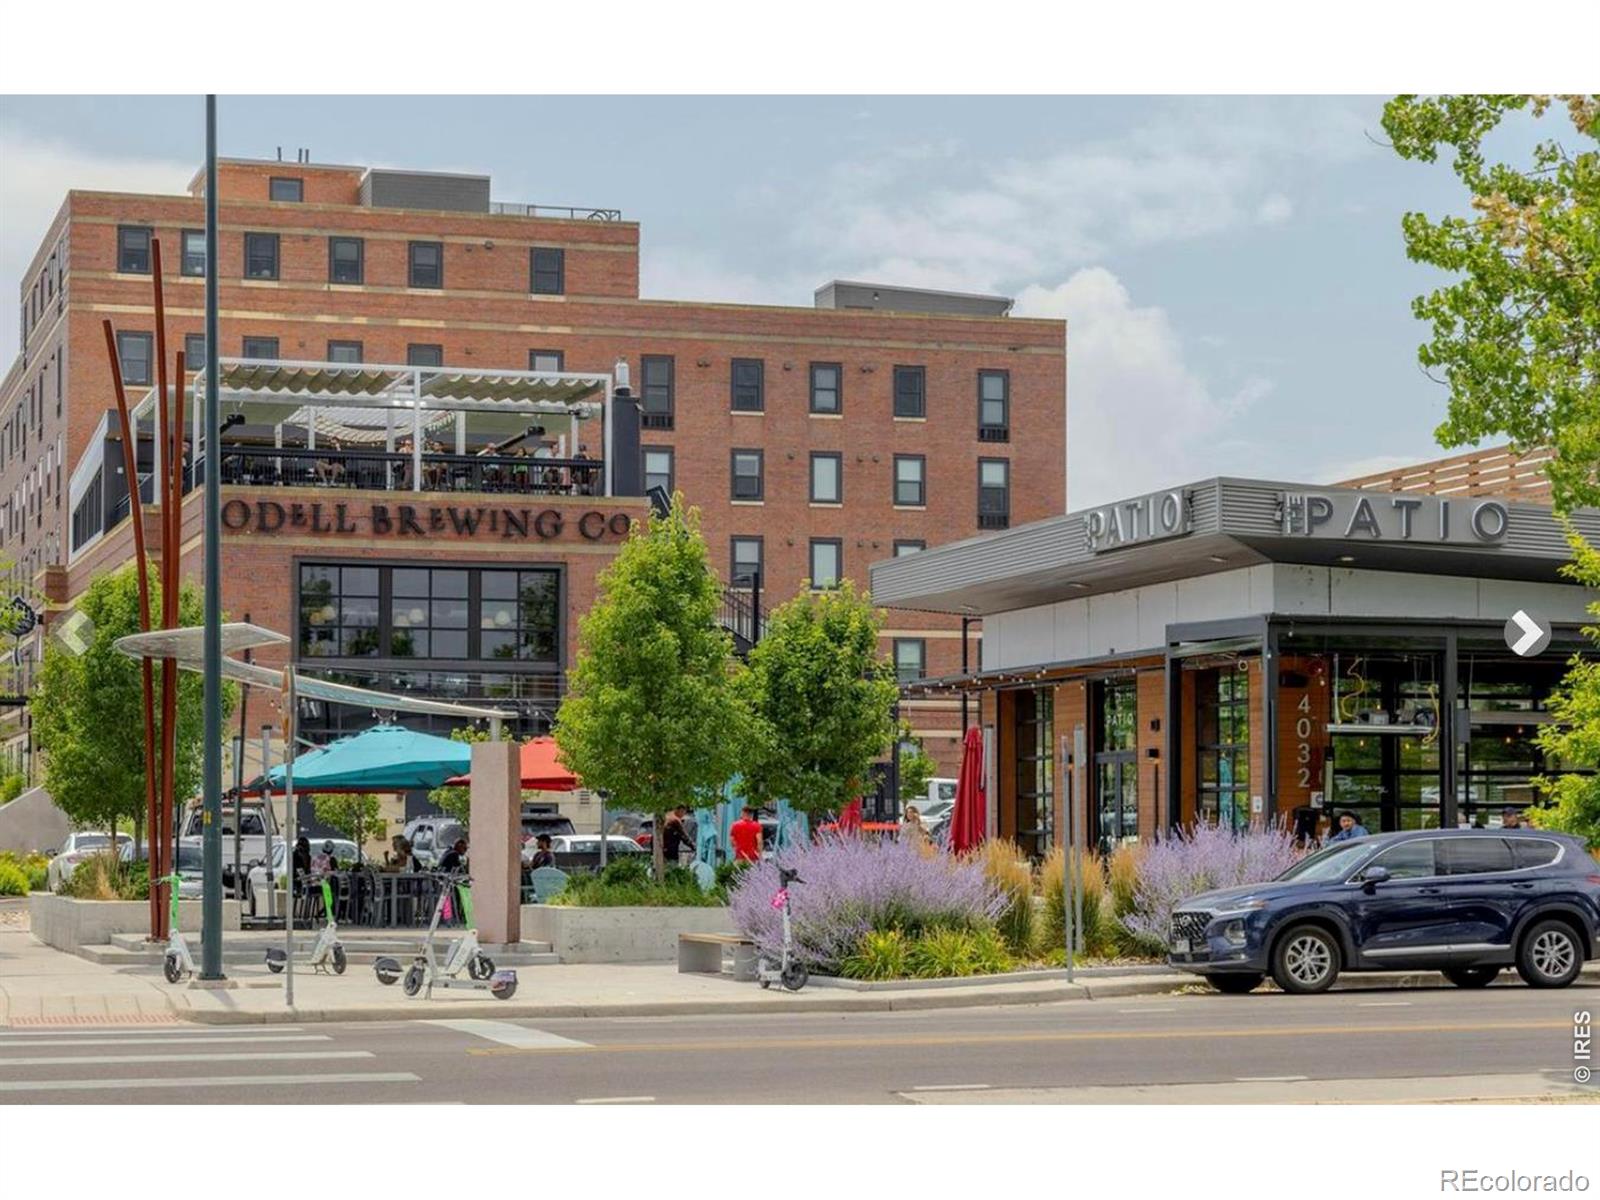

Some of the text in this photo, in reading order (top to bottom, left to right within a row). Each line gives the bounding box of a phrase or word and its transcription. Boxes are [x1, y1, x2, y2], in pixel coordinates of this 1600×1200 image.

[220, 499, 631, 541] ODELL BREWING CO
[1090, 492, 1181, 548] PATIO
[1304, 493, 1509, 543] PATIO
[1296, 693, 1311, 788] 4032
